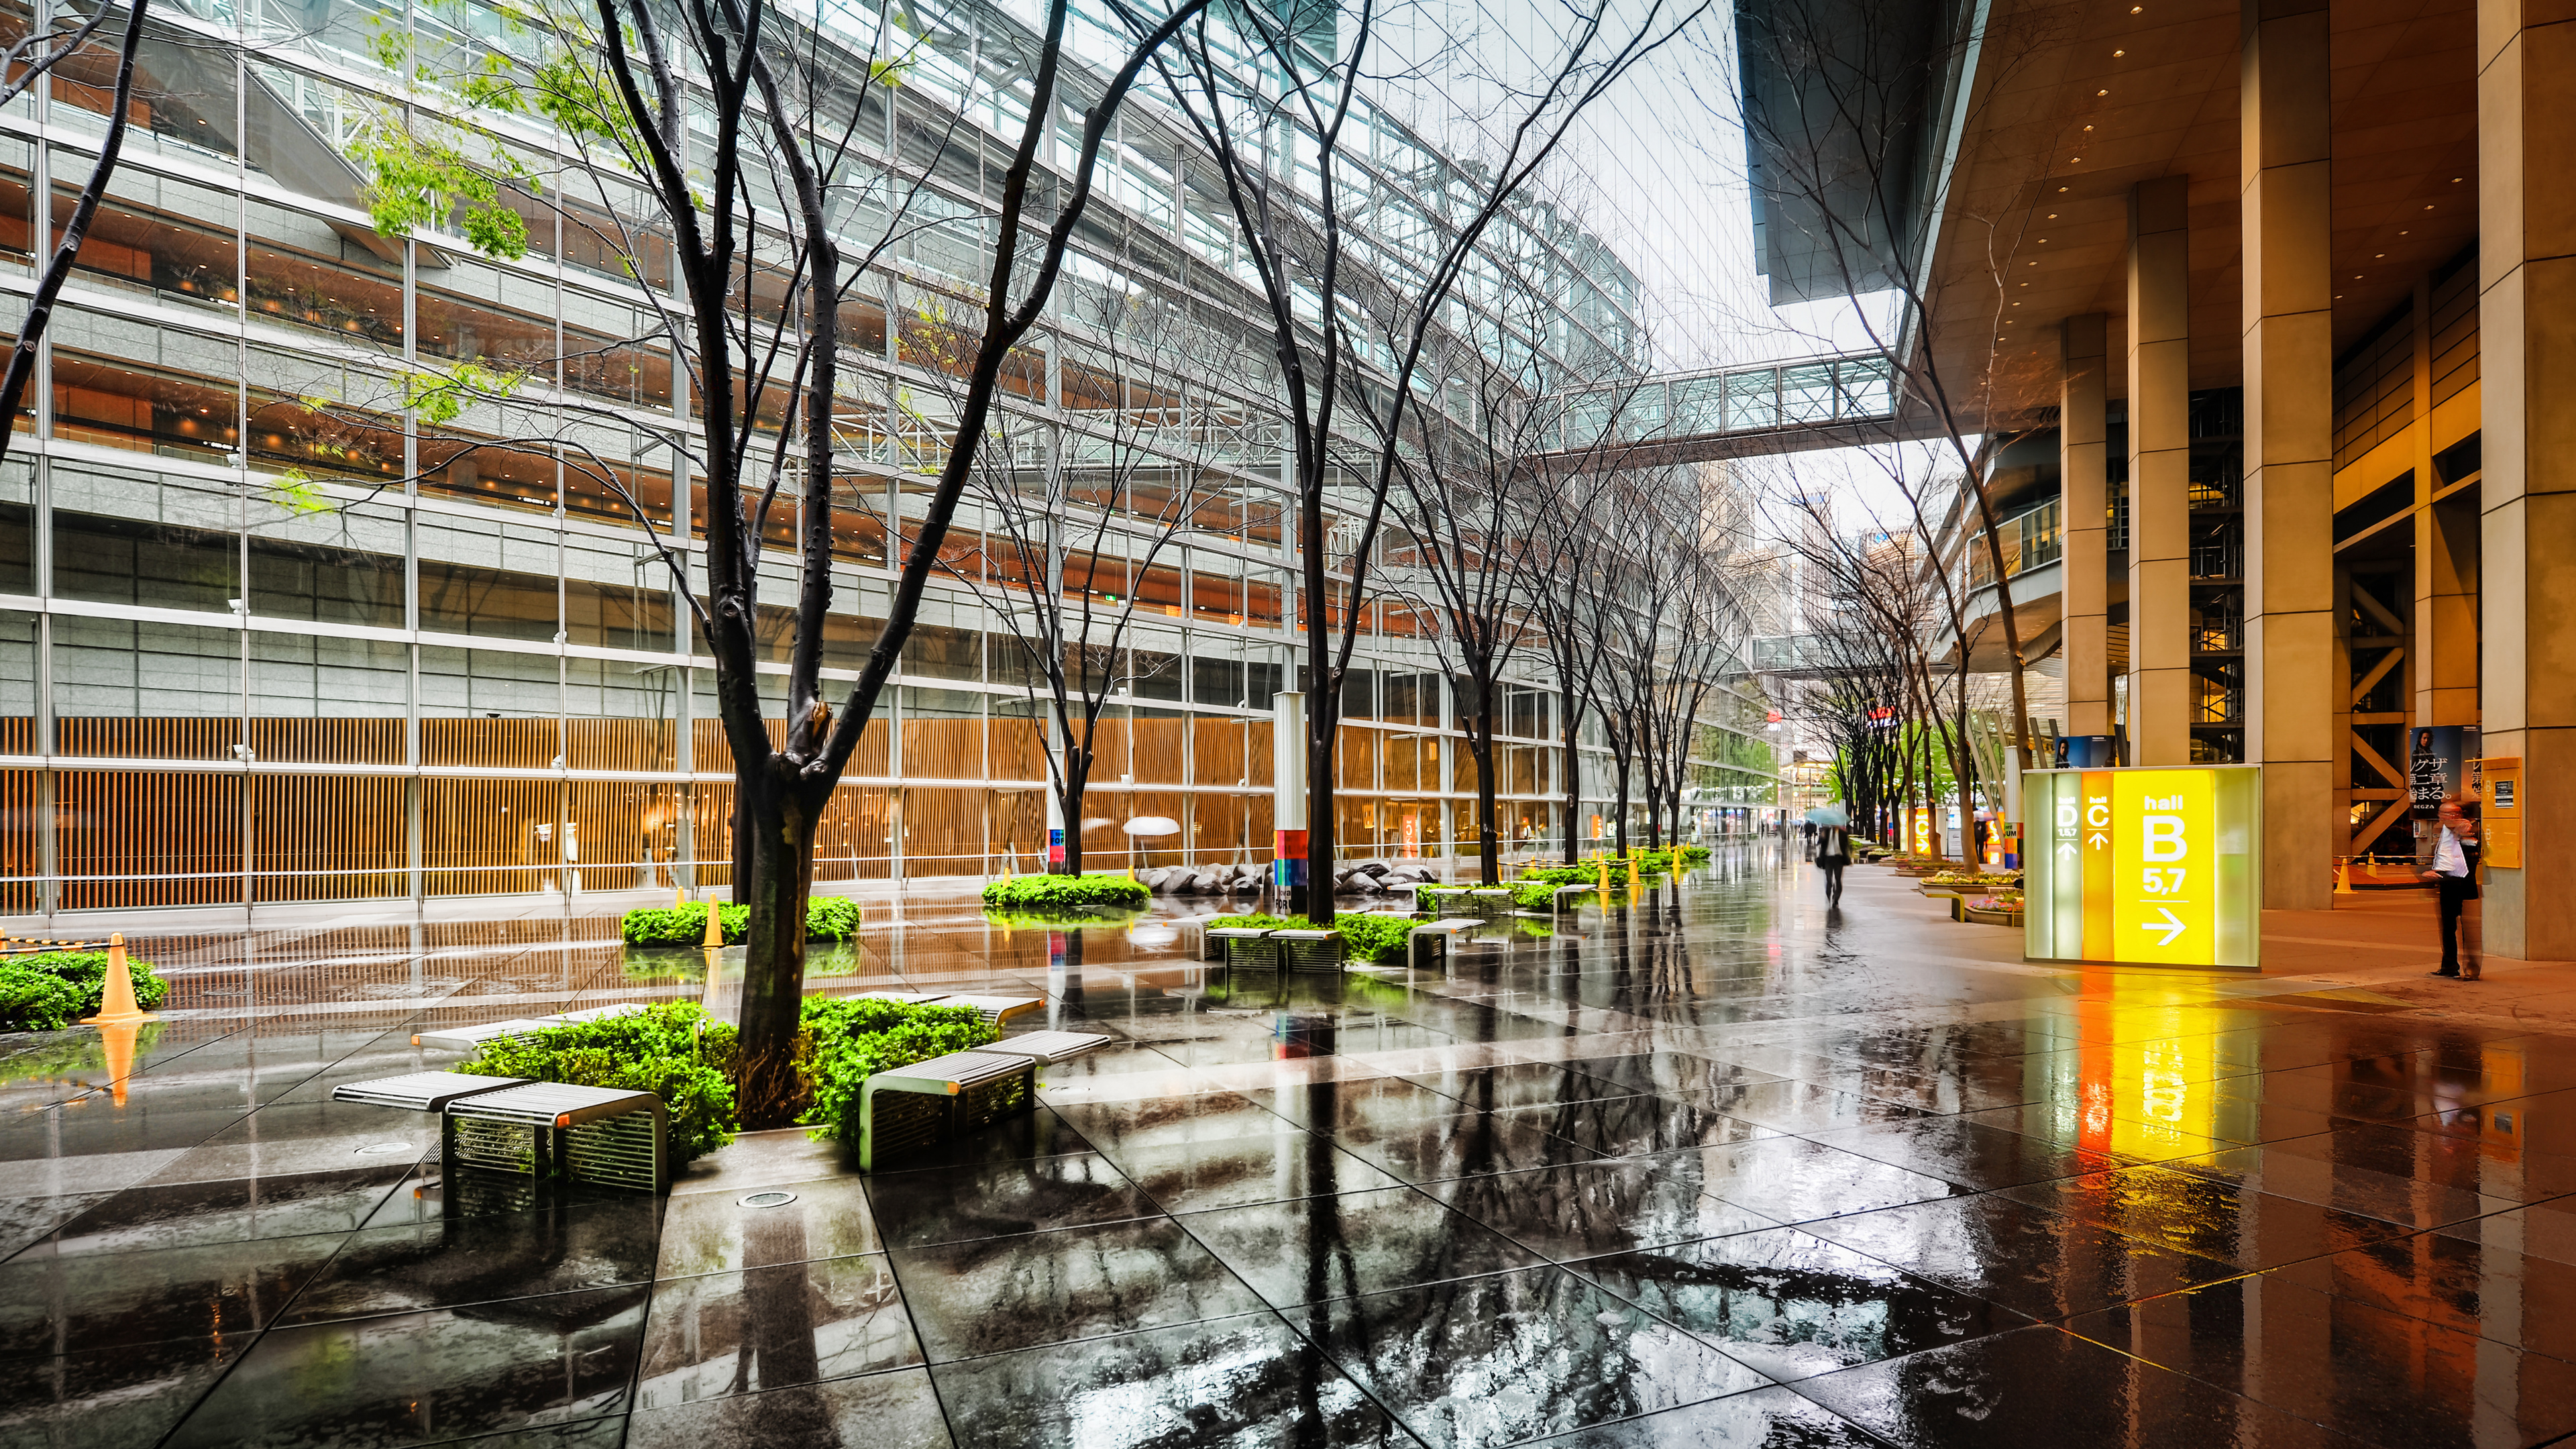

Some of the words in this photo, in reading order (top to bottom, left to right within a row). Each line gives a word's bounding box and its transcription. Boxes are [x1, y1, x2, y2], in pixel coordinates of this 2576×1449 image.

[2145, 795, 2183, 810] hall
[2057, 805, 2078, 826] D
[2088, 805, 2109, 826] C
[1915, 820, 1929, 836] C
[2058, 828, 2077, 837] 1,5,7
[2143, 815, 2188, 862] B
[2143, 868, 2186, 896] 5,7
